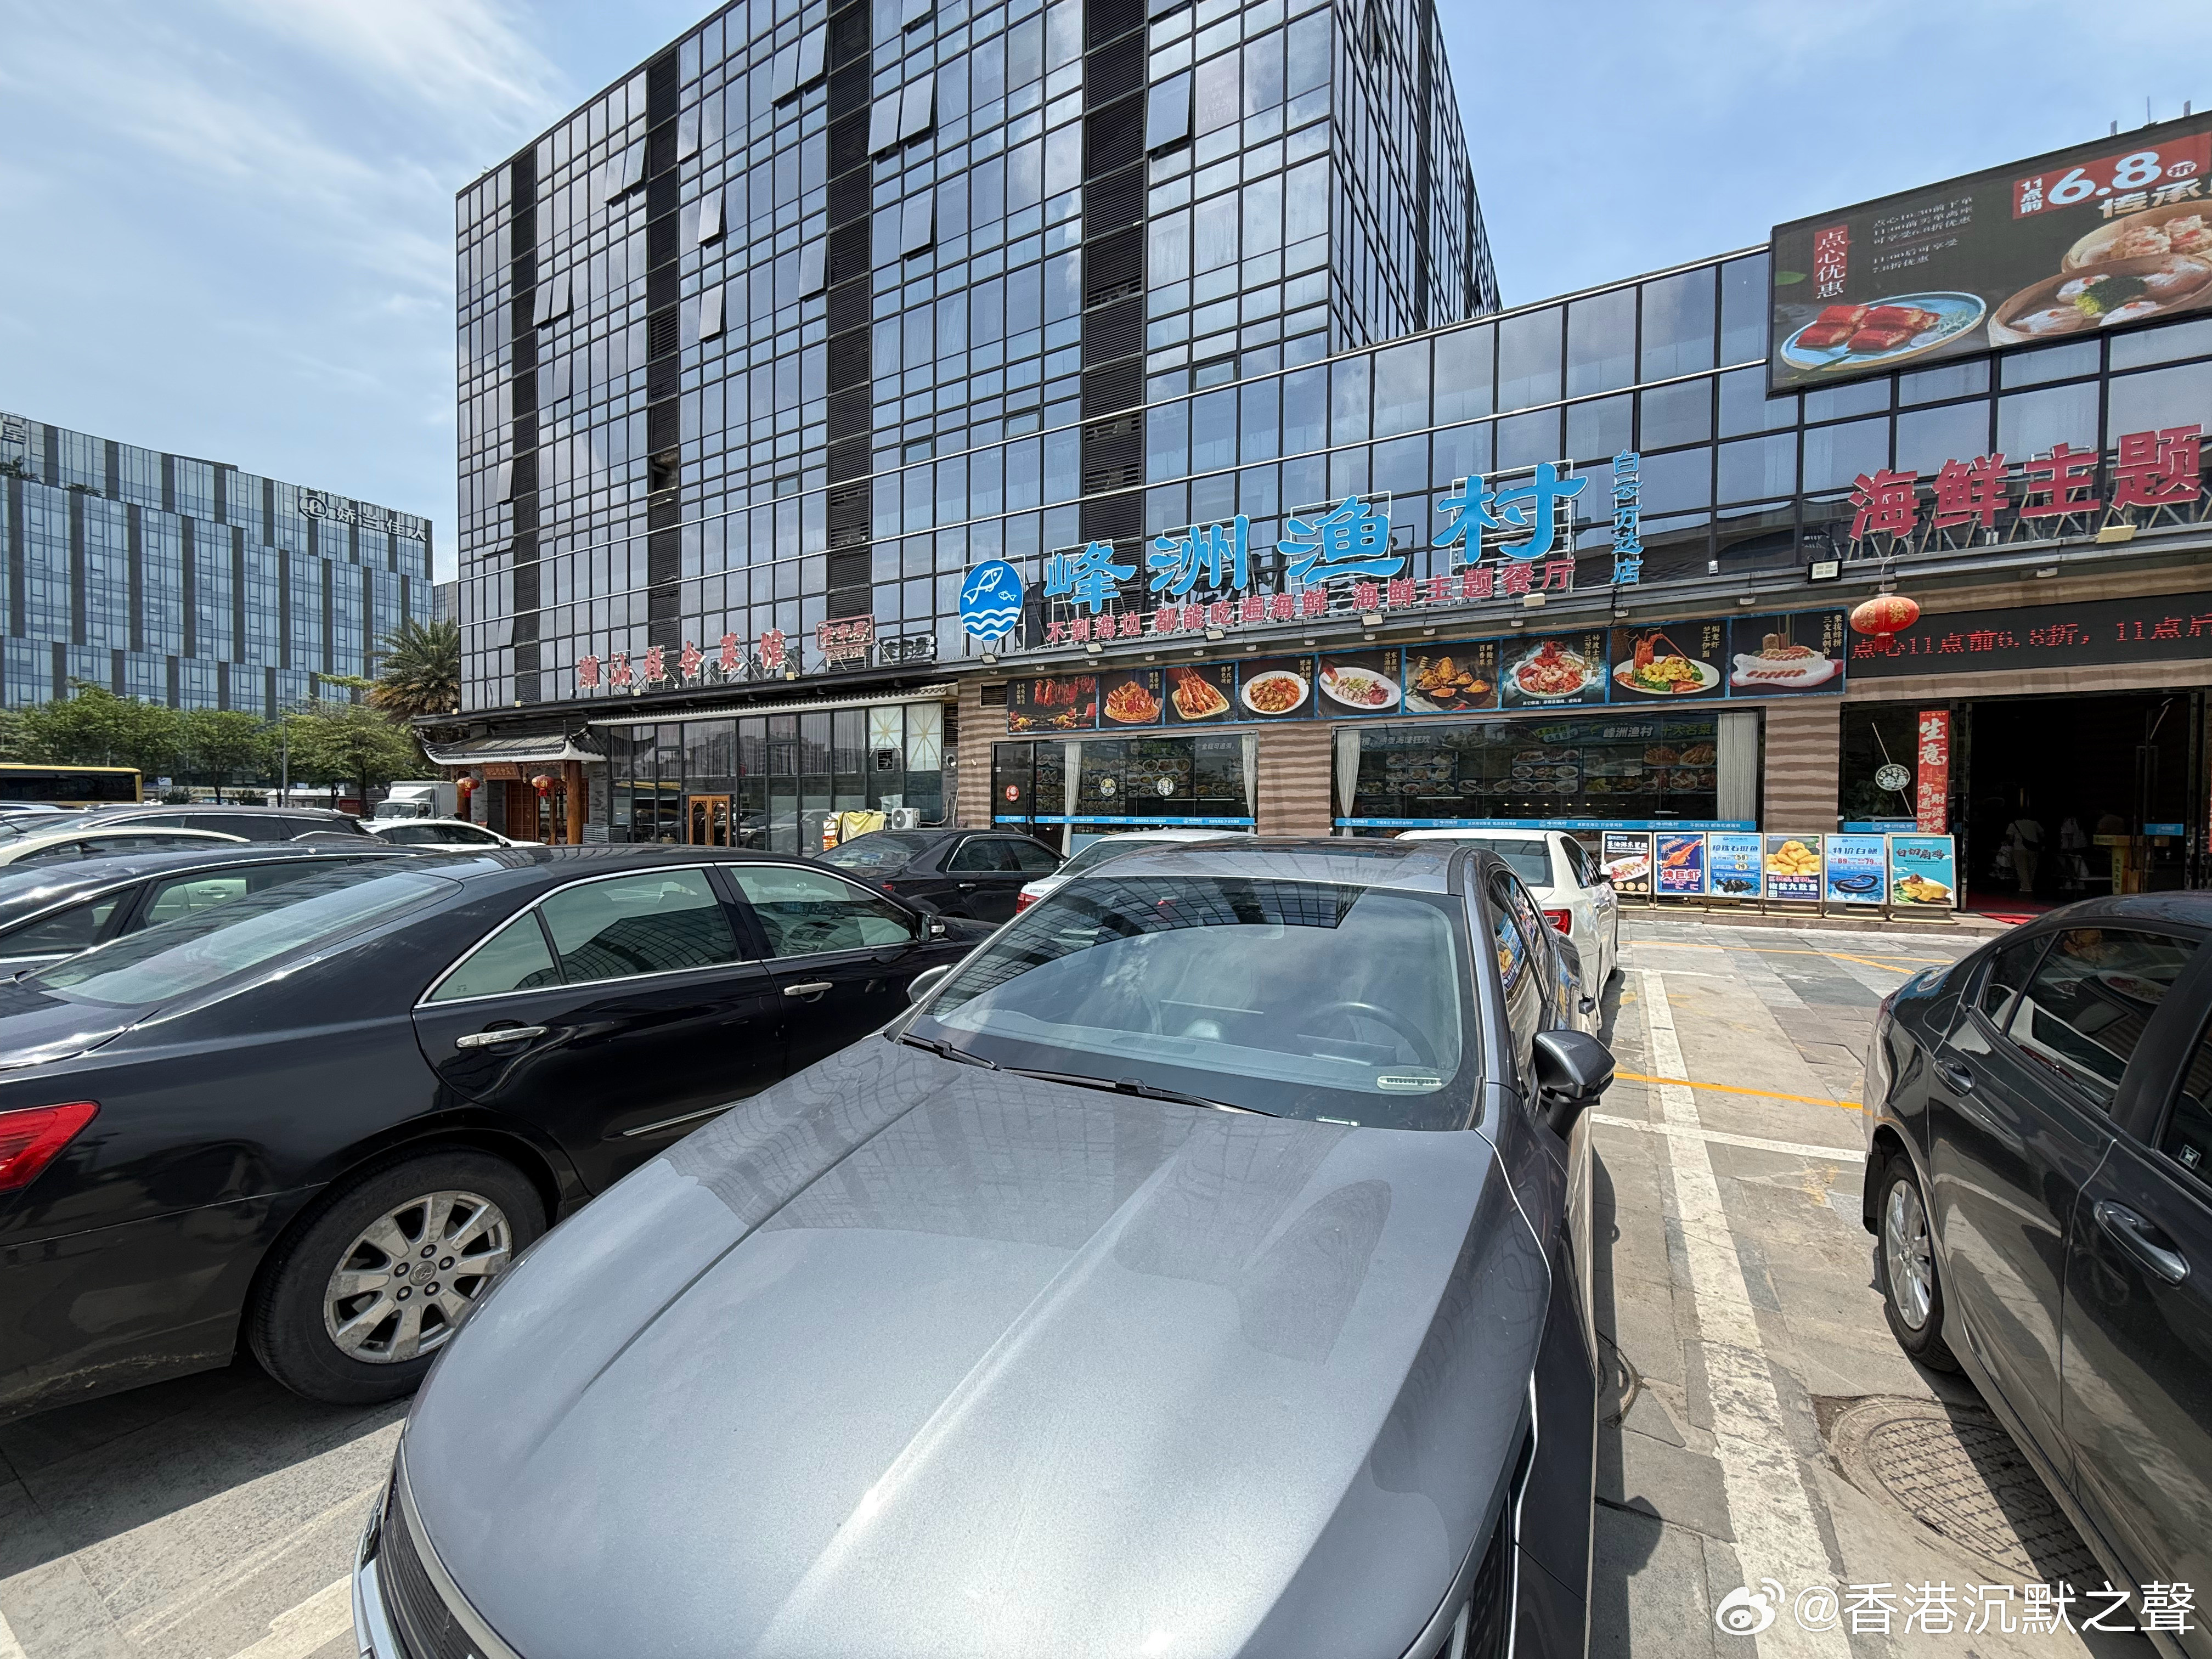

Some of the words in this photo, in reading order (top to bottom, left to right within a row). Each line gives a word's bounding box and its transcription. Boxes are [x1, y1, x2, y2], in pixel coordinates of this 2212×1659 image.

[2020, 177, 2044, 215] 11点前
[2047, 151, 2163, 205] 6.8
[2097, 178, 2212, 219] 传承
[1816, 230, 1846, 299] 点心优惠
[1847, 423, 2204, 541] 海鲜主题
[336, 506, 427, 543] 娇兰佳人
[1043, 463, 1588, 613] 峰洲渔村
[1610, 449, 1644, 584] 白云万达店
[1046, 611, 1142, 644] 不到海边
[1155, 588, 1328, 633] 都能吃遍海鲜
[1351, 559, 1576, 611] 海鲜主题餐厅
[1702, 626, 1711, 658] 芝士伊面
[1822, 616, 1832, 656] 三文鱼刺身
[1603, 726, 1654, 738] 峰洲渔村
[1919, 718, 1947, 766] 生意
